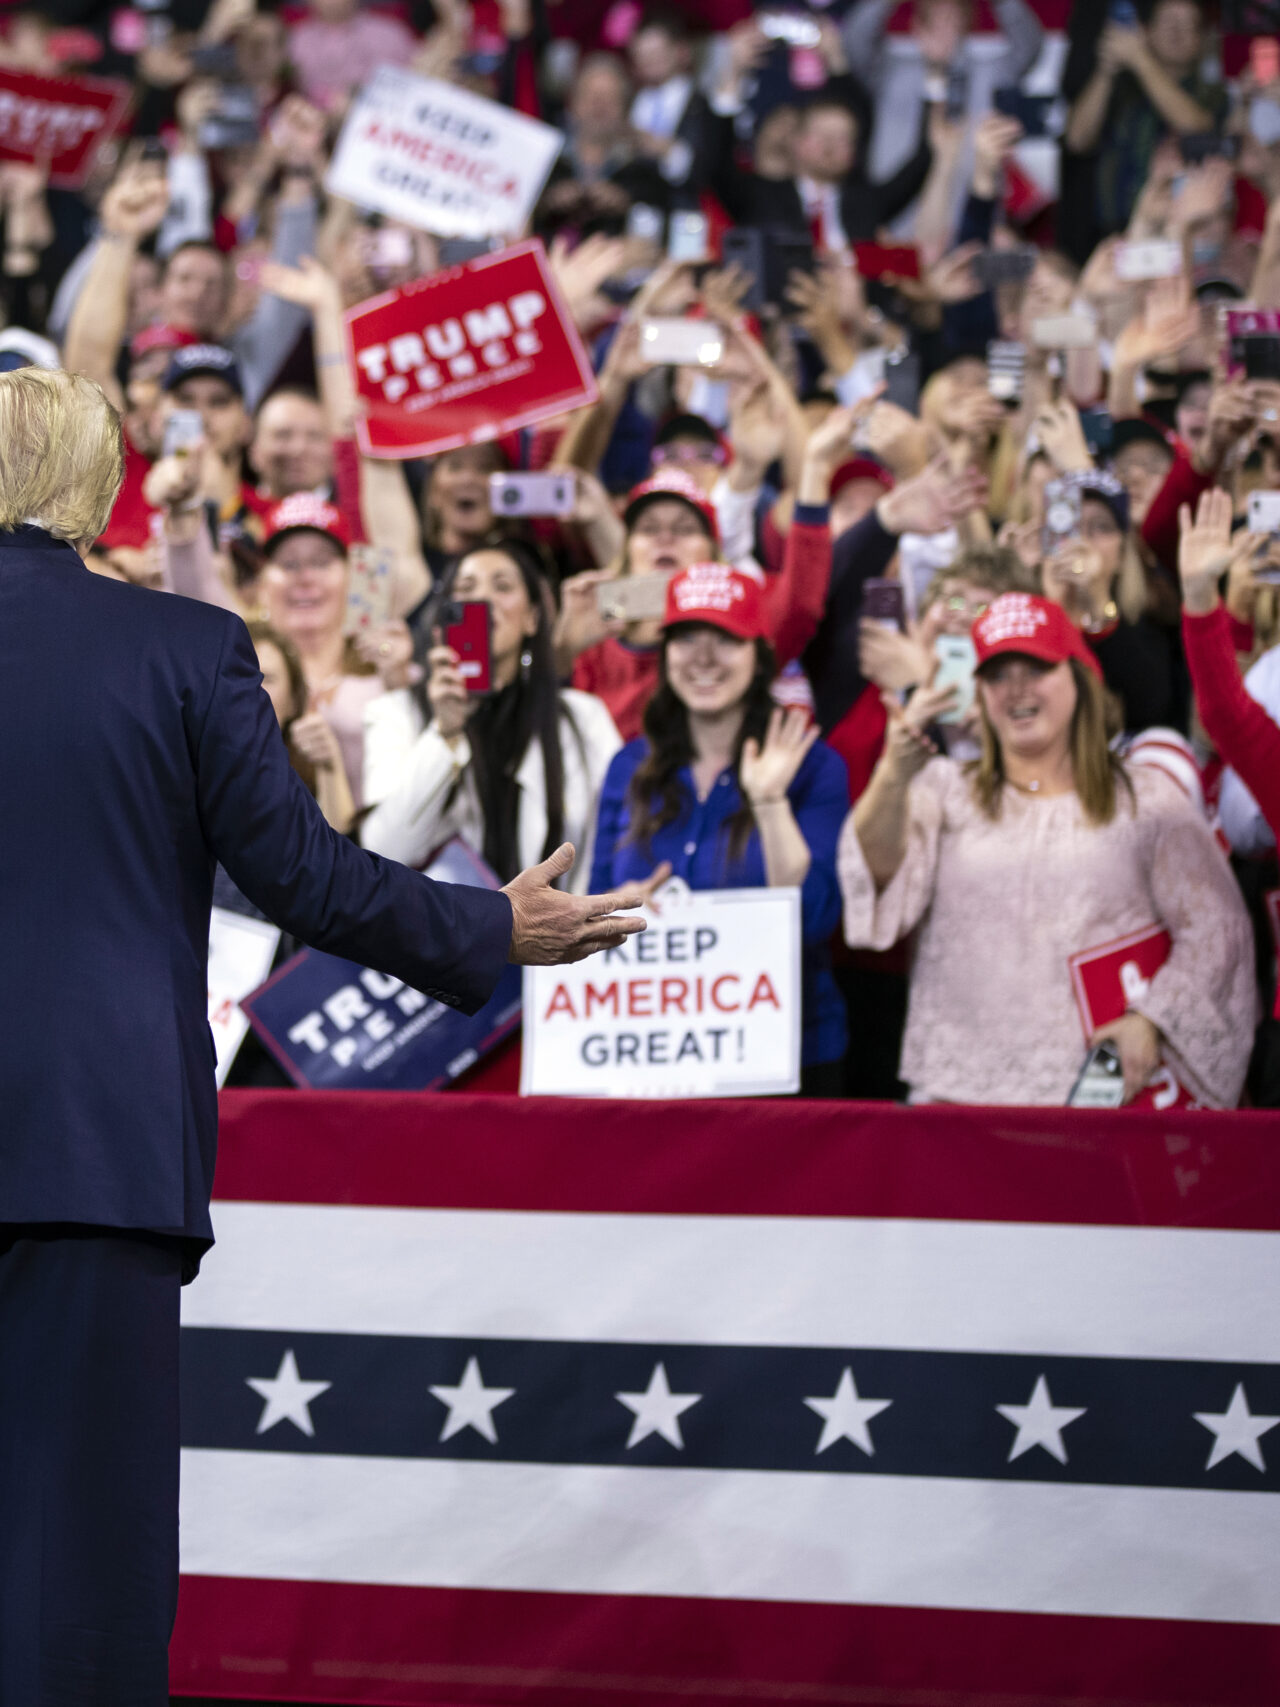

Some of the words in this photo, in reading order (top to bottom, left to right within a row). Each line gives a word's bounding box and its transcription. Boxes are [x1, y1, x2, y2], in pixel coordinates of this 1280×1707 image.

[358, 290, 546, 383] TRUMP
[382, 328, 542, 403] PENCE
[604, 927, 718, 965] KEEP
[287, 967, 408, 1053] TRU
[331, 984, 427, 1068] PEN
[544, 973, 781, 1022] AMERICA
[581, 1027, 745, 1067] GREAT!
